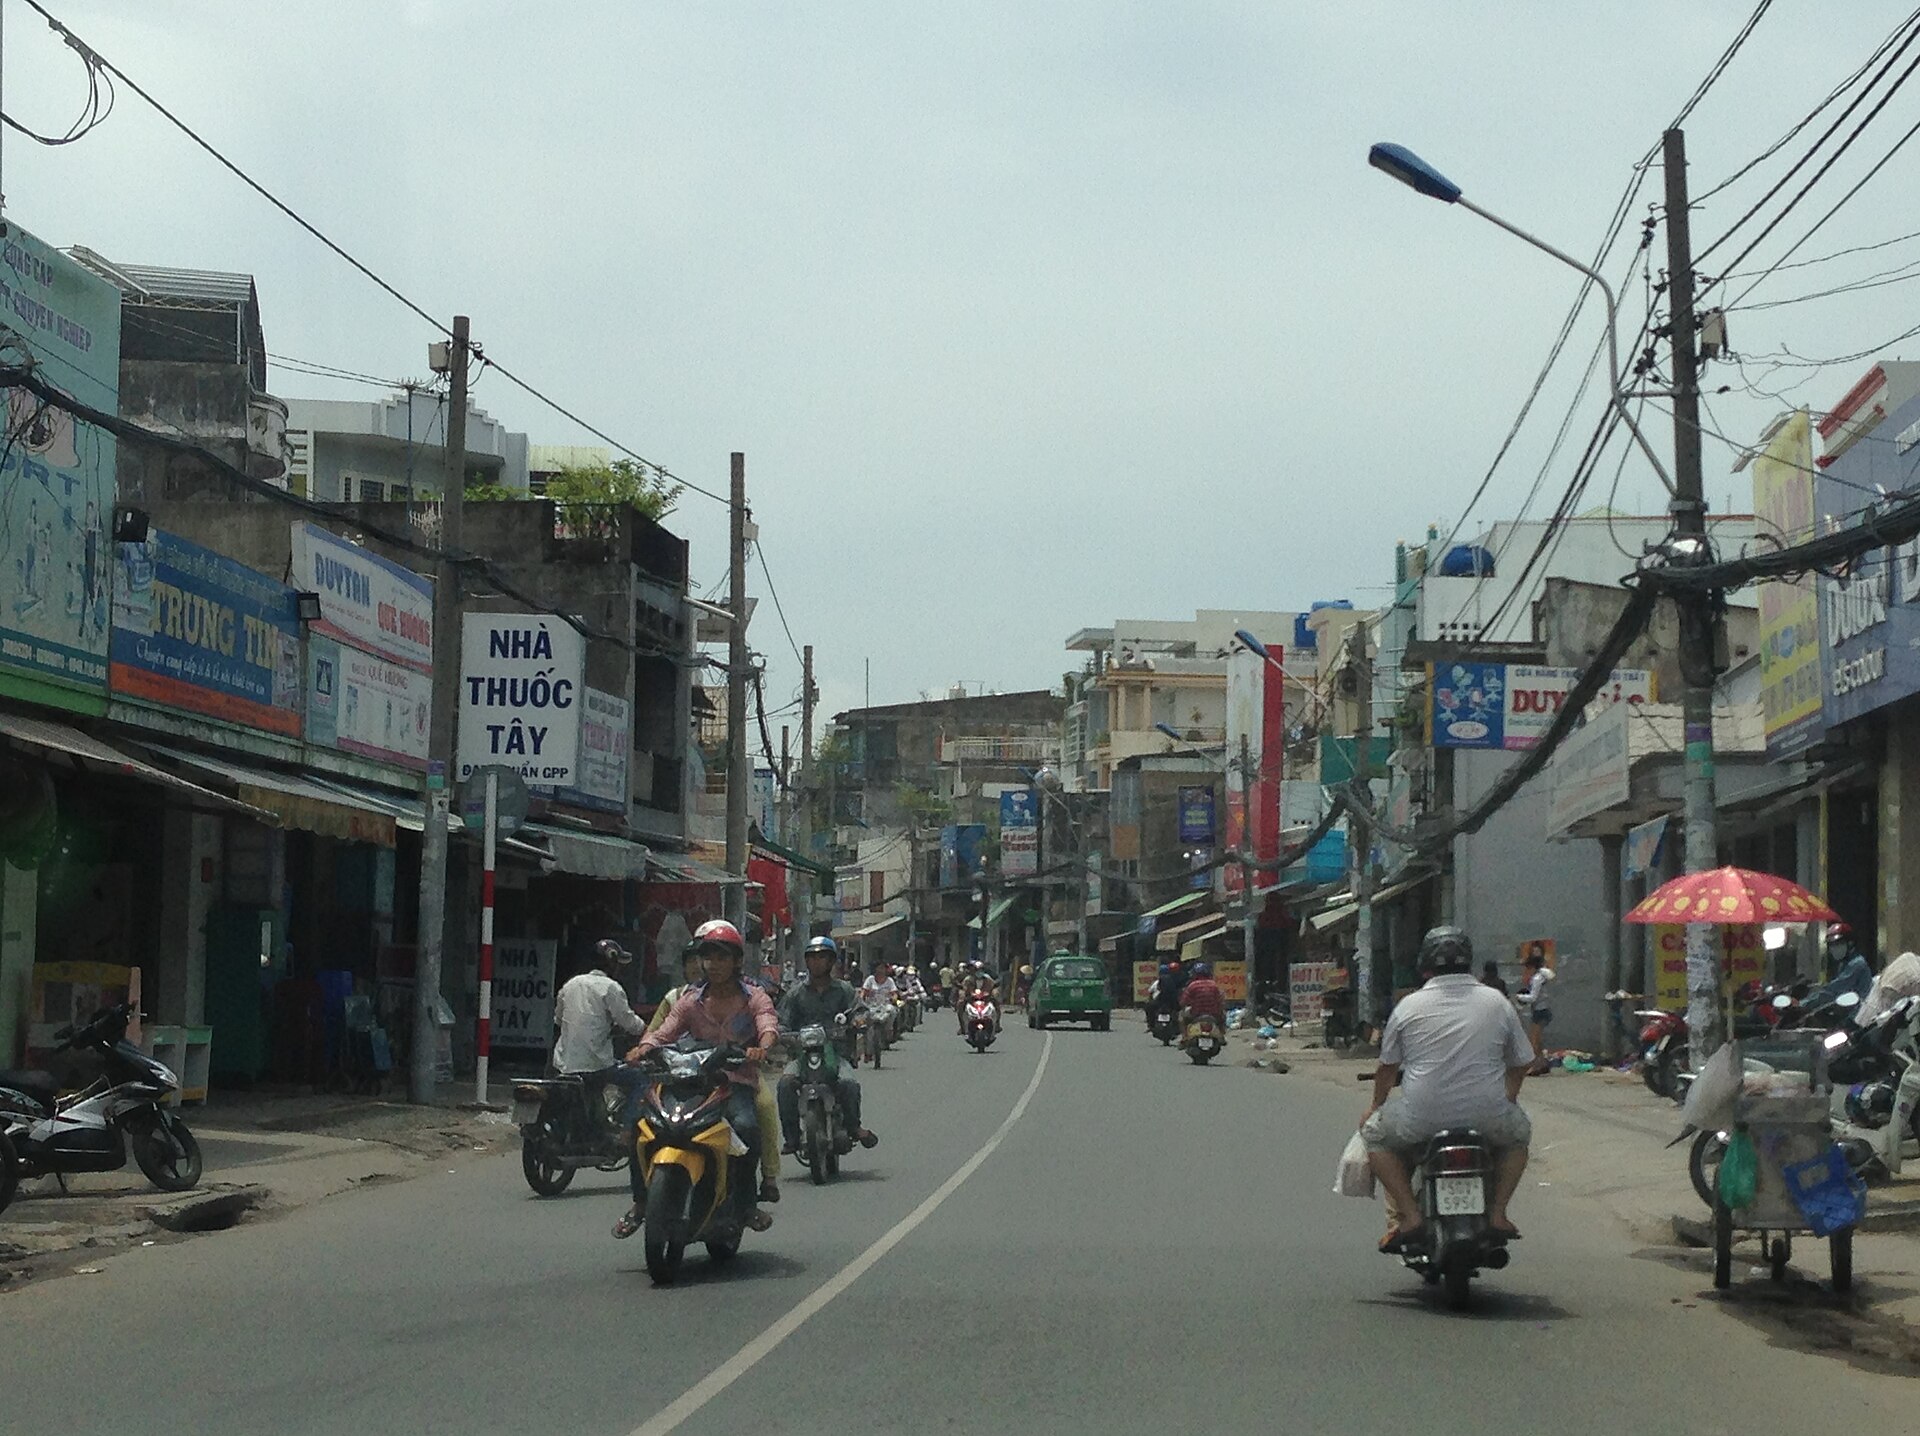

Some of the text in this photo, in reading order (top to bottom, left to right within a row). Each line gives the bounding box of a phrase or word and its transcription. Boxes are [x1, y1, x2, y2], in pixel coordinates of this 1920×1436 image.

[152, 580, 235, 656] TRUNG
[489, 623, 552, 659] NHÀ
[466, 667, 573, 708] THUỐC
[1512, 689, 1567, 713] DUY
[486, 718, 548, 755] TÂY
[543, 767, 569, 779] GPP
[501, 944, 538, 968] NHÀ
[496, 1005, 531, 1029] TÂY
